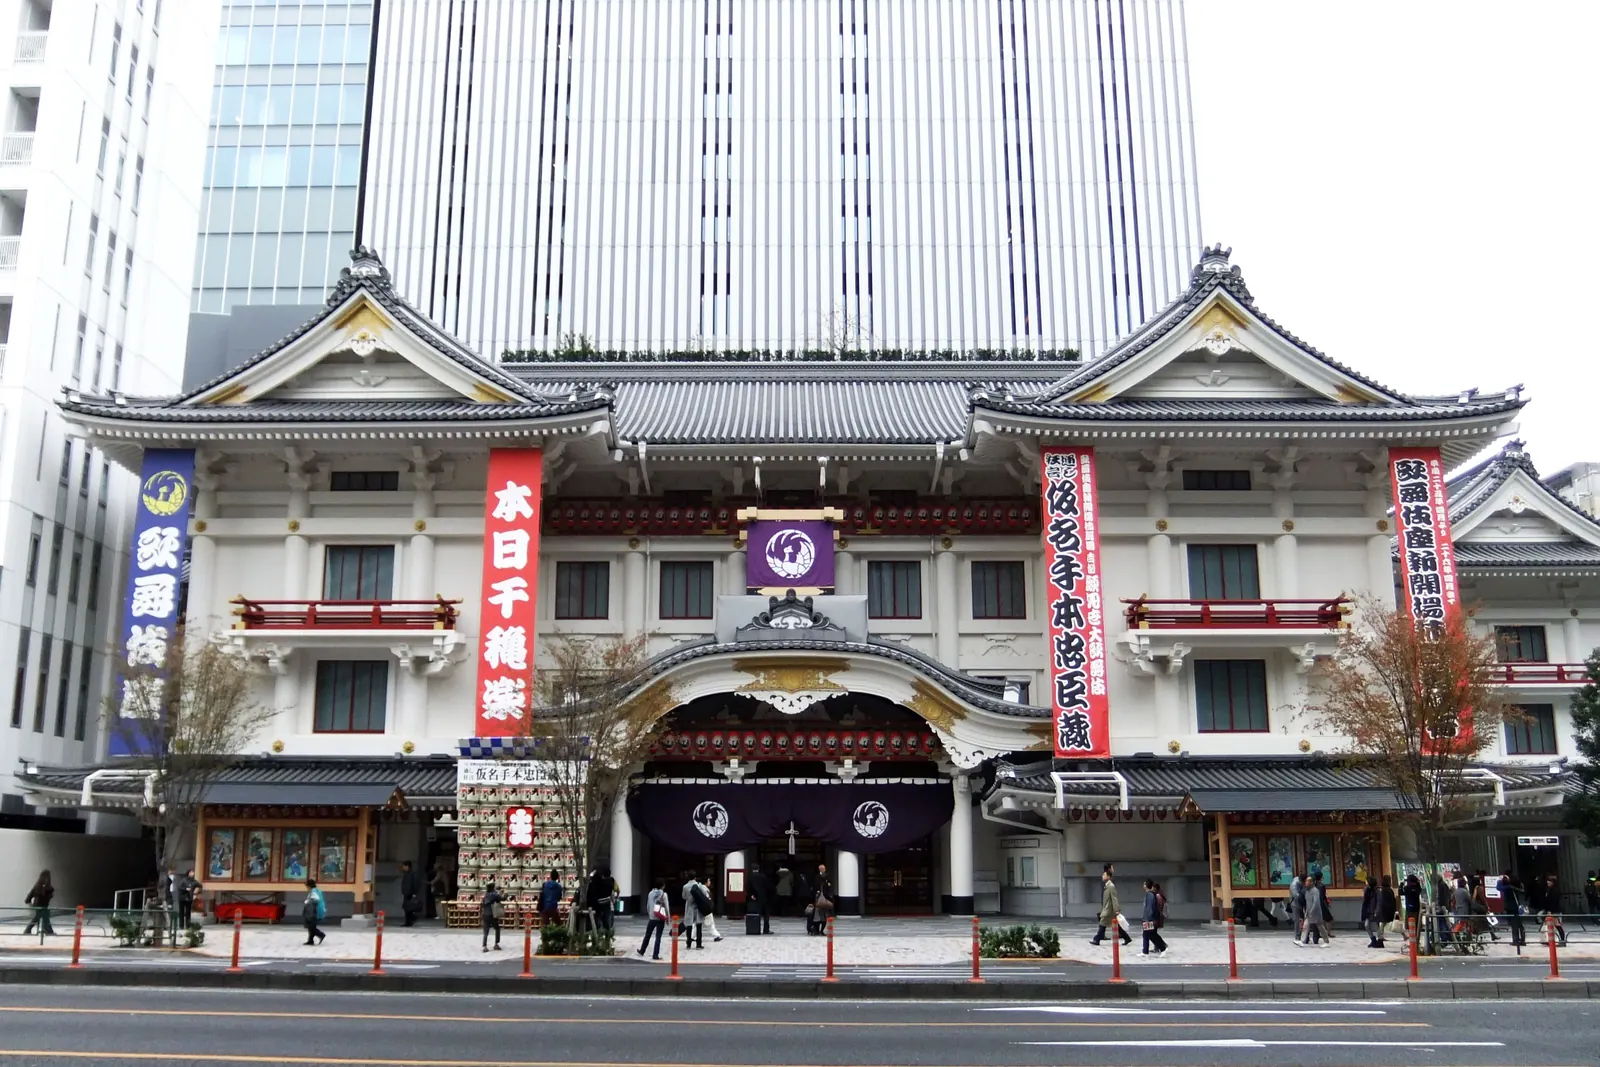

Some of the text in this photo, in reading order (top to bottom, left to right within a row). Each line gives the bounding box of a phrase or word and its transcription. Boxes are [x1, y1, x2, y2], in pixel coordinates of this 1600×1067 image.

[481, 480, 534, 720] 本日千穐楽
[1045, 479, 1093, 751] 仮名手本忠臣蔵
